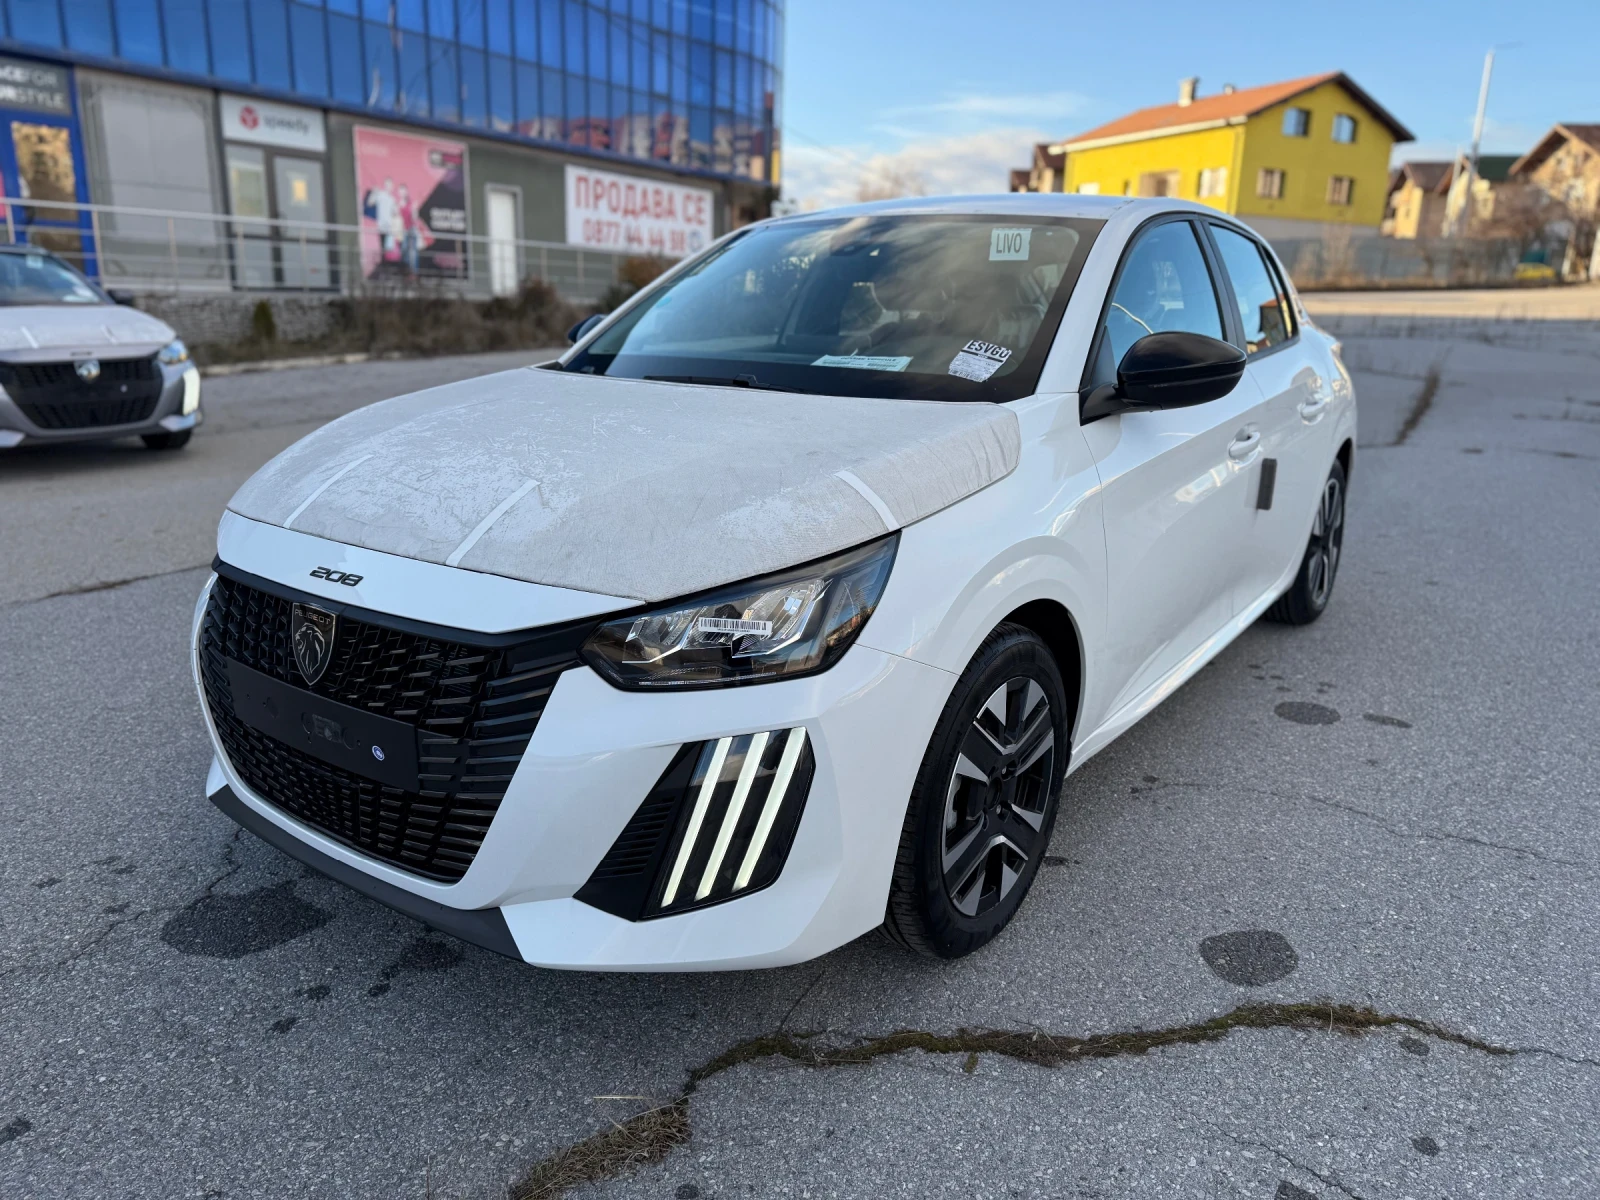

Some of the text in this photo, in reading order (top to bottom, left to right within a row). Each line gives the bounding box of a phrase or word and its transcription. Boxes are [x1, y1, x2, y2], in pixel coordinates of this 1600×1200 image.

[575, 175, 706, 226] ПРОДАВА СЕ
[583, 218, 620, 245] 0877
[996, 232, 1022, 254] LIVO
[309, 565, 364, 588] 208
[294, 608, 331, 625] PEUGEOT
